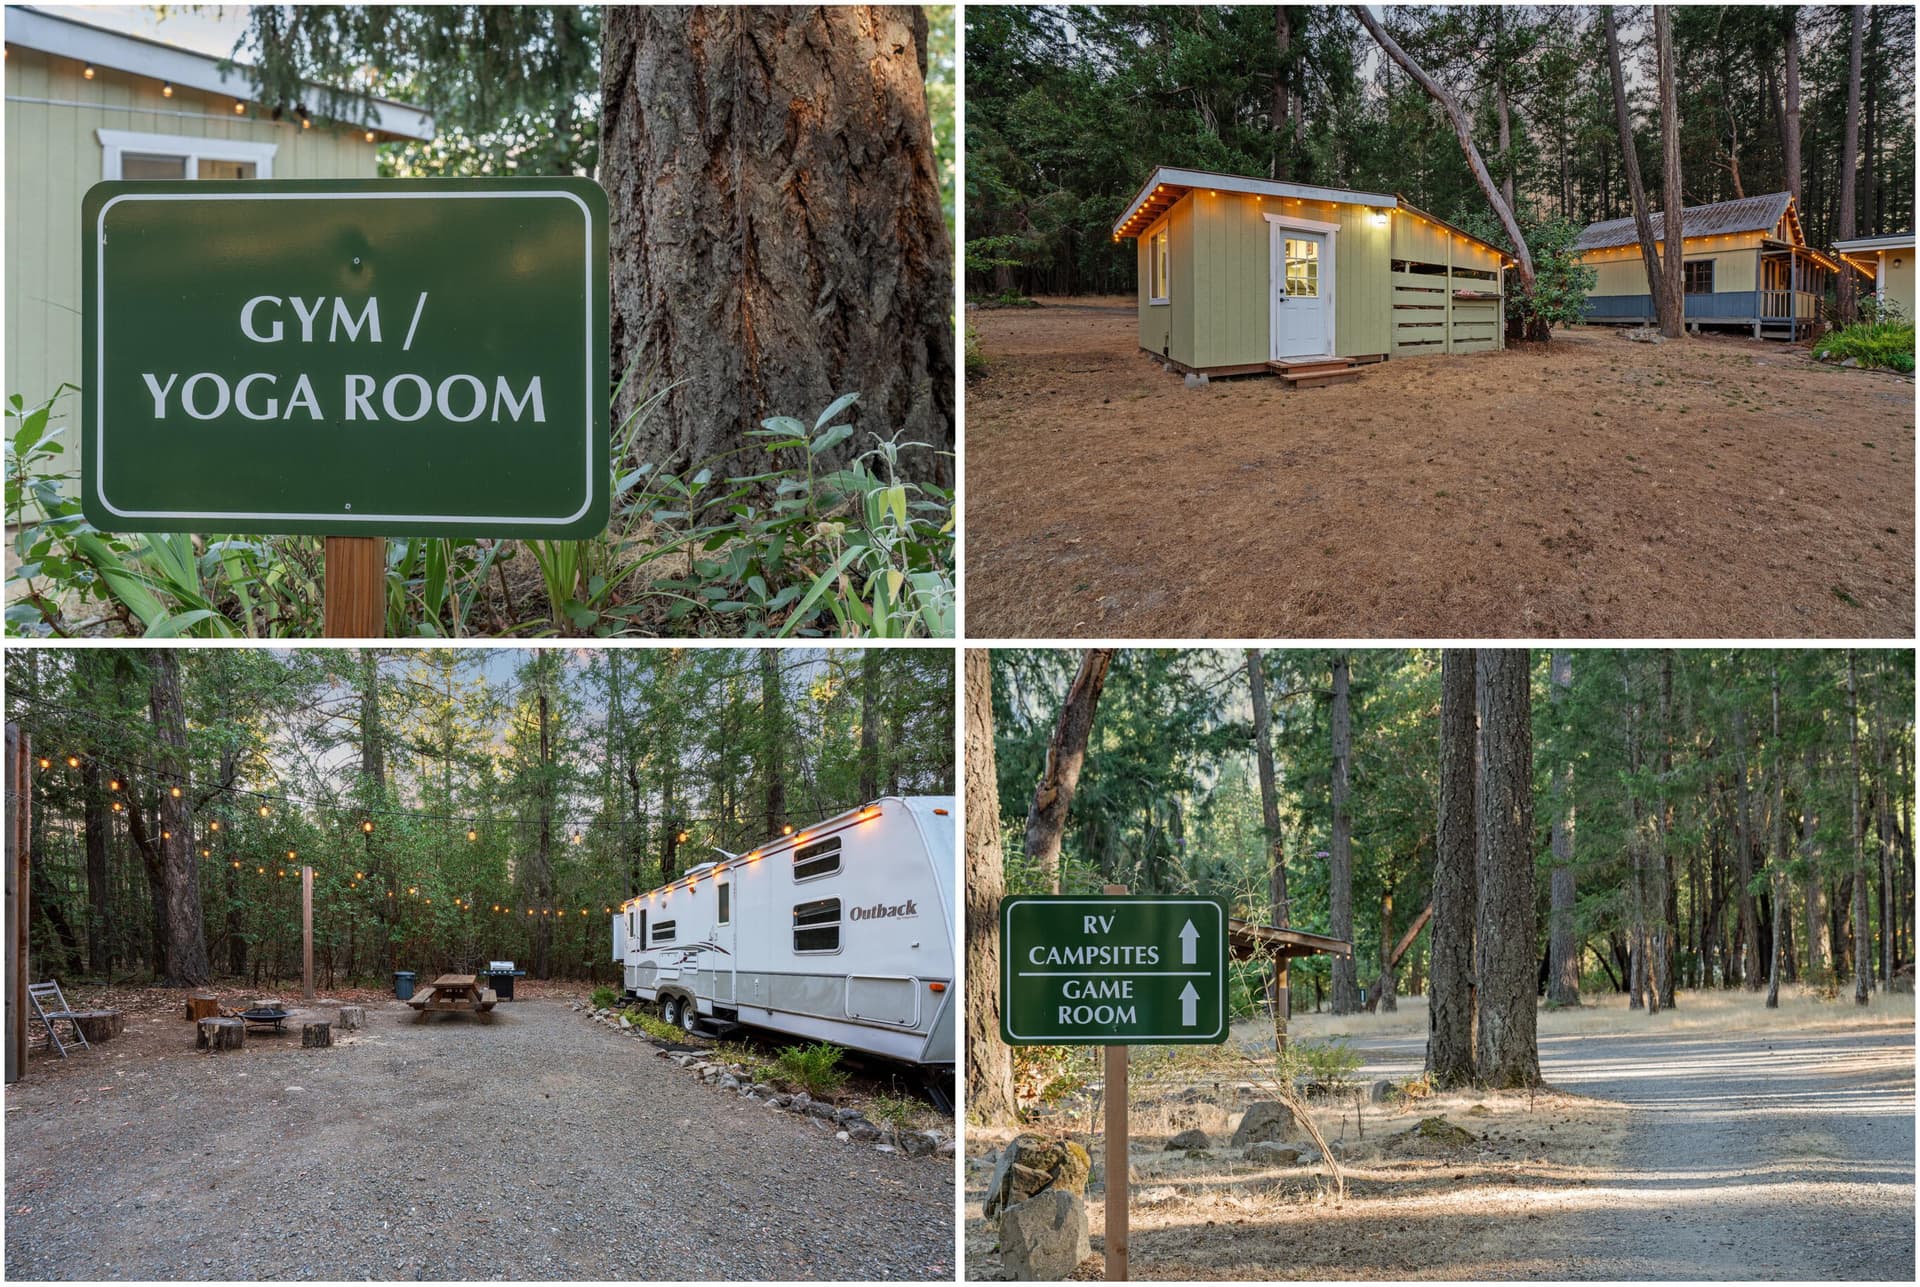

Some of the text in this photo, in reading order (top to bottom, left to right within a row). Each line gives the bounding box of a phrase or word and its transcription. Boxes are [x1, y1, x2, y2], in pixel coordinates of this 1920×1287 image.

[239, 294, 383, 344] GYM
[141, 372, 546, 423] YOGA ROOM
[850, 899, 918, 921] Outback
[1083, 915, 1115, 934] RV
[1028, 946, 1160, 965] CAMPSITES
[1062, 980, 1133, 999] GAME
[1058, 1005, 1137, 1025] ROOM
